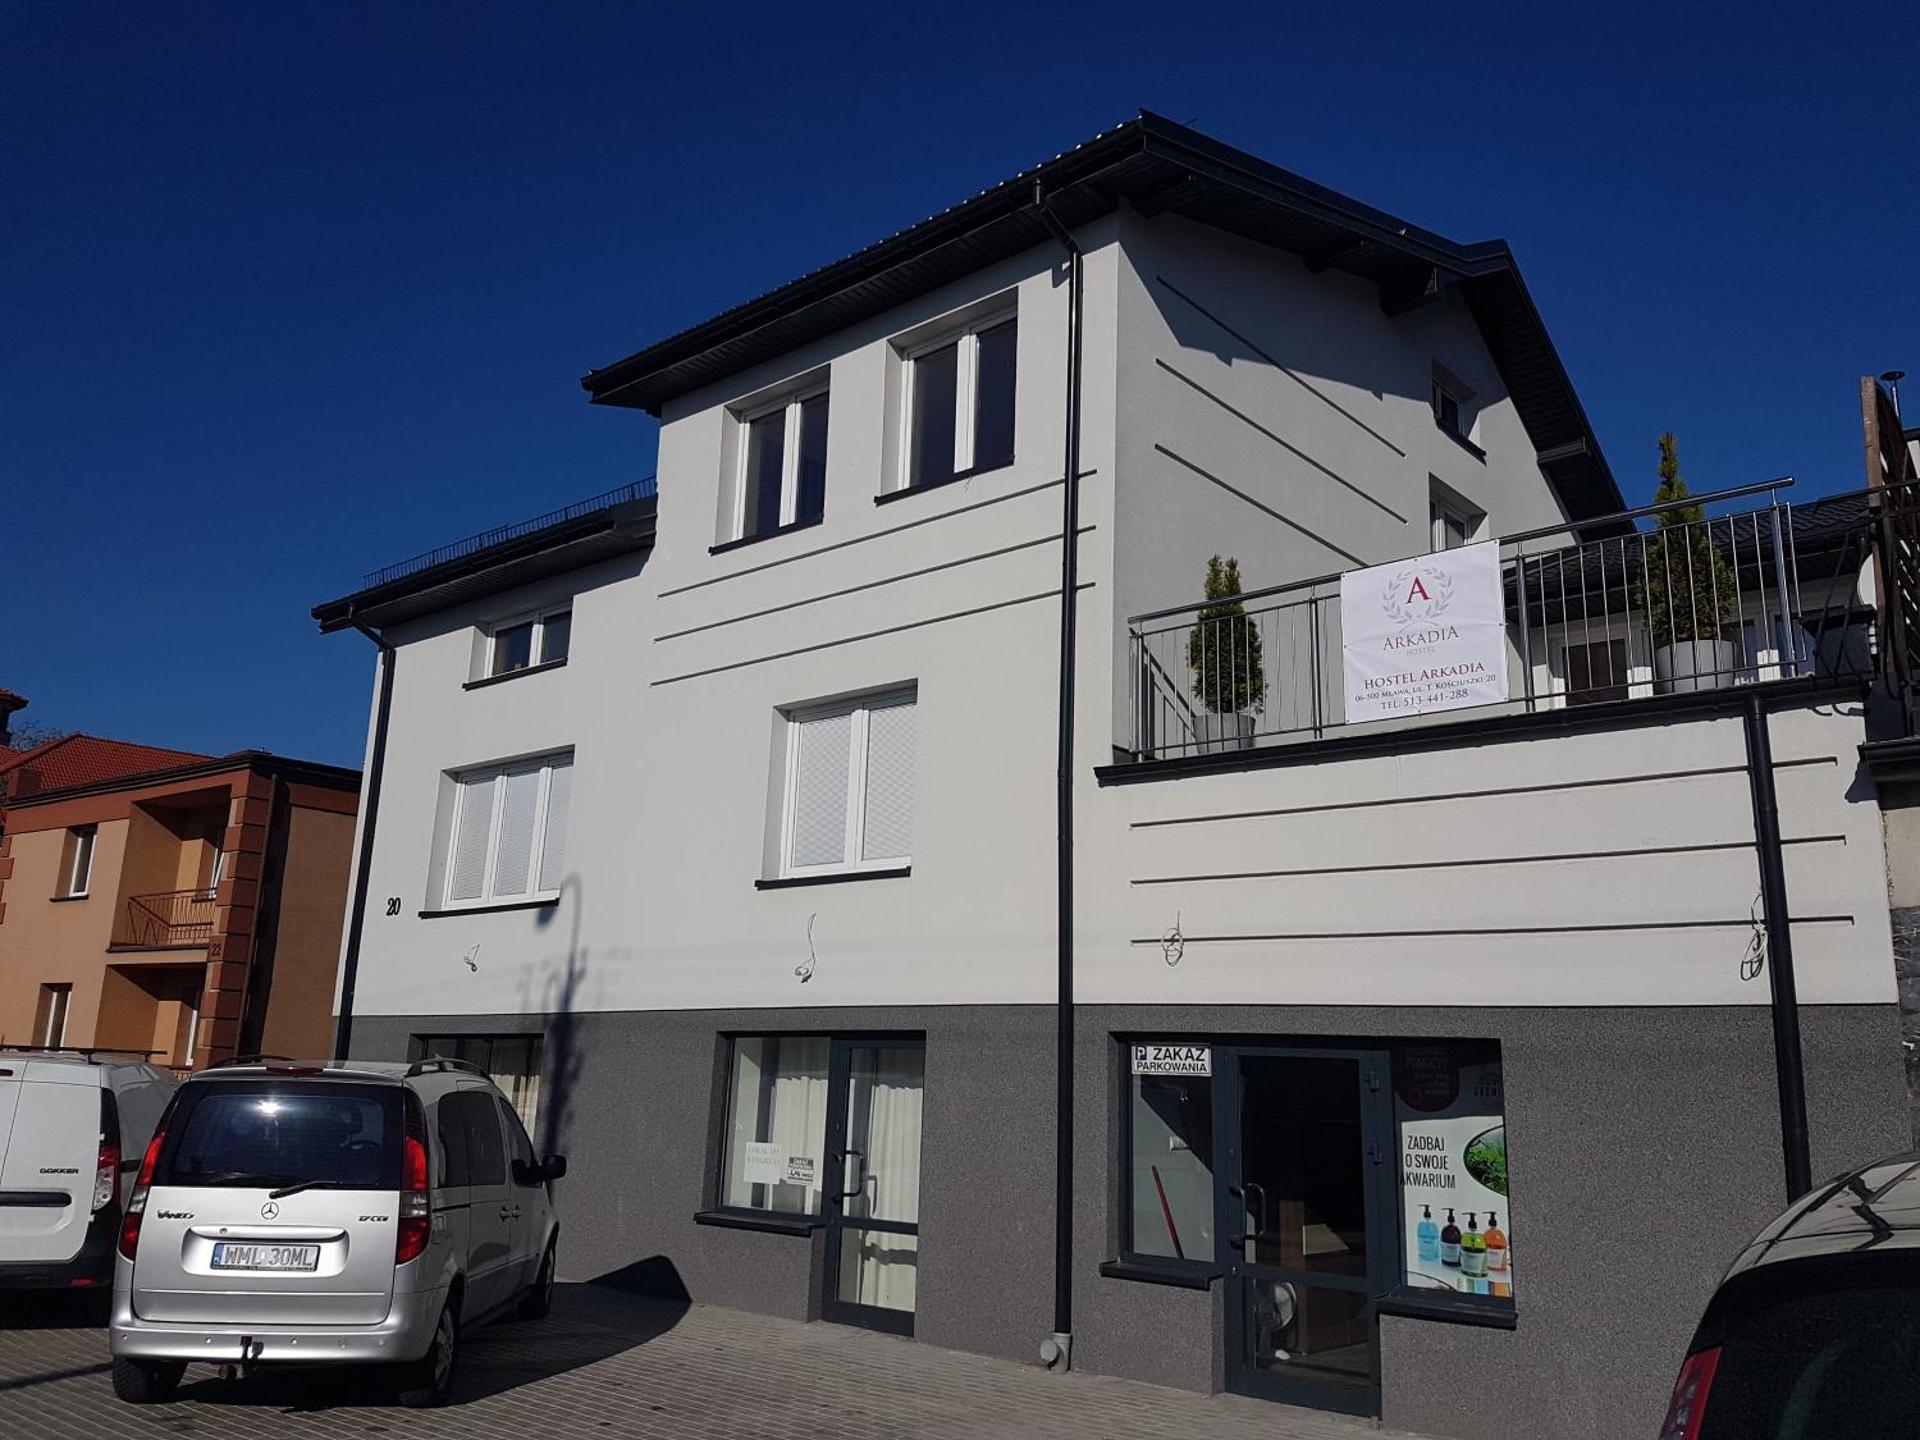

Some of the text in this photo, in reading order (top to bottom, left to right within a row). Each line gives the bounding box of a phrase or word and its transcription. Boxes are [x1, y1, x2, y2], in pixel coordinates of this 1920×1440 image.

[1405, 576, 1432, 604] A
[1383, 626, 1460, 651] ARKADIA
[1364, 661, 1485, 690] HOSTEL ARKADIA
[386, 897, 401, 916] 20
[1153, 1047, 1206, 1062] ZAKAZ
[1137, 1061, 1207, 1072] PARKOWANIA
[1407, 1135, 1445, 1152] ZADBAJ
[1405, 1153, 1449, 1170] O SWOJE
[223, 1245, 261, 1265] WML
[268, 1247, 313, 1267] 30ML
